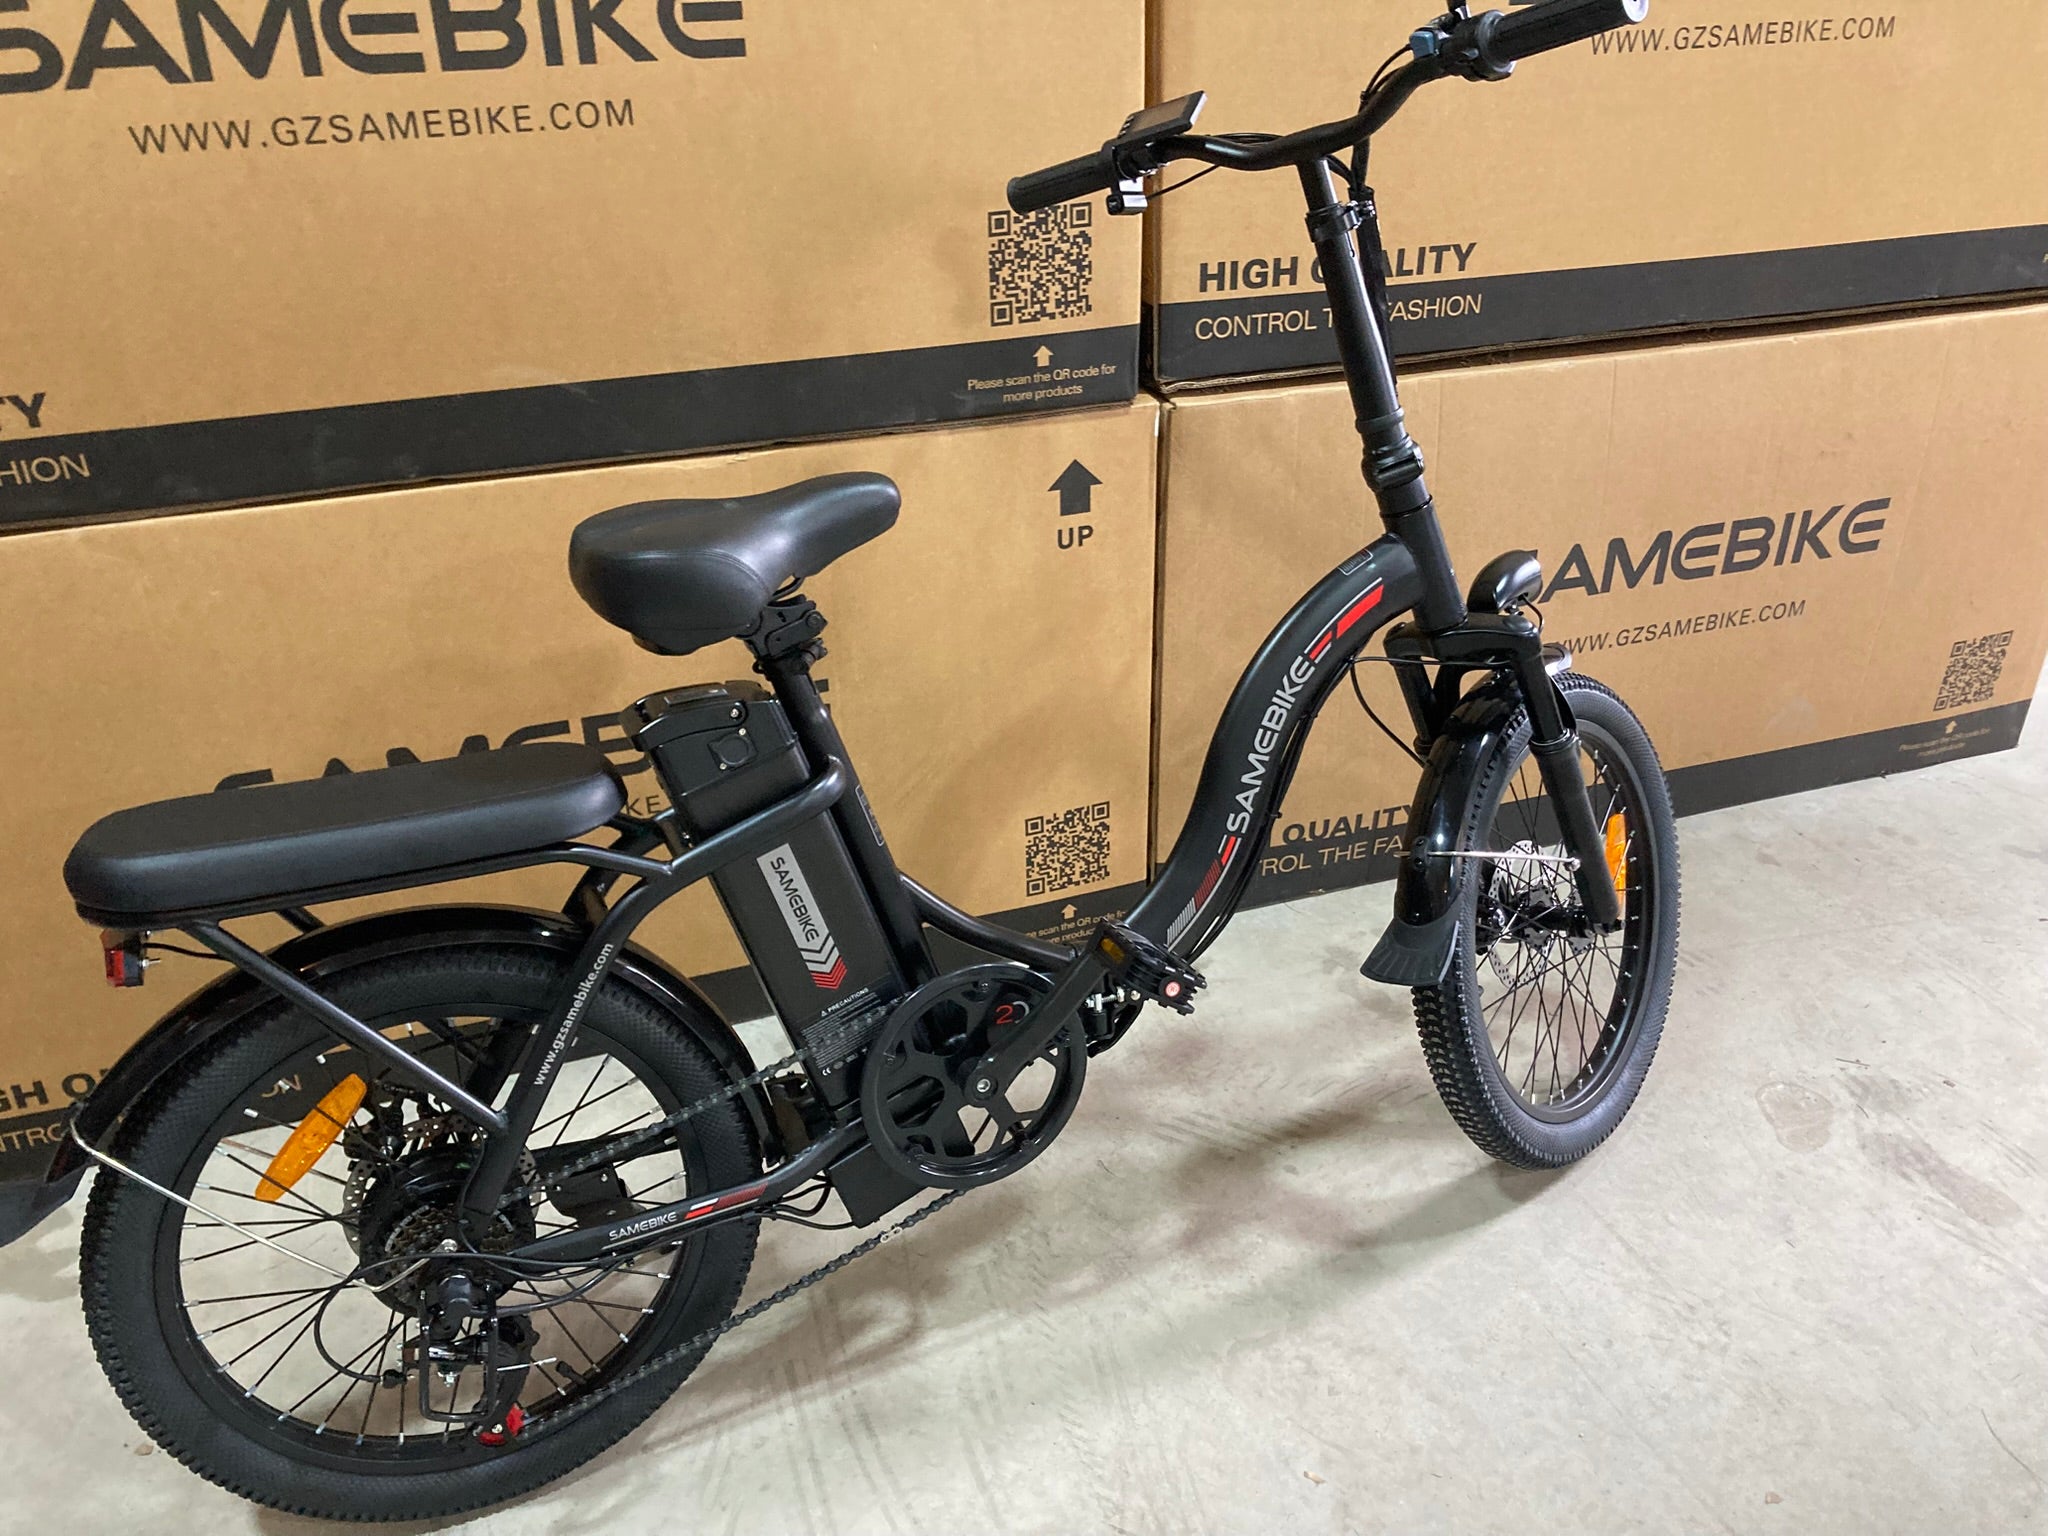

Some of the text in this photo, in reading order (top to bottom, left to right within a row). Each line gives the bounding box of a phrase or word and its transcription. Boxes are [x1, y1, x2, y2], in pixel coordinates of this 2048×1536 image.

[1590, 15, 1896, 55] WWW.GZSAMEBIKE.COM
[128, 98, 636, 155] WWW.GZSAMEBIKE.COM
[1199, 255, 1299, 293] HIGH
[1194, 309, 1318, 341] CONTROL
[1387, 293, 1483, 322] ASHION
[967, 363, 1117, 391] Please scan the QR code for
[1003, 383, 1084, 404] more products
[1057, 525, 1094, 550] UP
[1530, 497, 1891, 604] AMEBIKE
[1556, 599, 1806, 656] WW.GZSAMEBIKE.COM
[1225, 654, 1316, 834] SAMEBIKE
[1318, 841, 1369, 866] THE
[770, 856, 820, 943] SAMEBIKE
[1038, 925, 1060, 937] scan
[1061, 920, 1076, 931] the
[1076, 916, 1092, 927] QR
[532, 942, 614, 1087] www.gzsamebike.com
[827, 987, 869, 1013] PRECAUTIONS
[609, 1210, 678, 1242] SAMEBIKE
